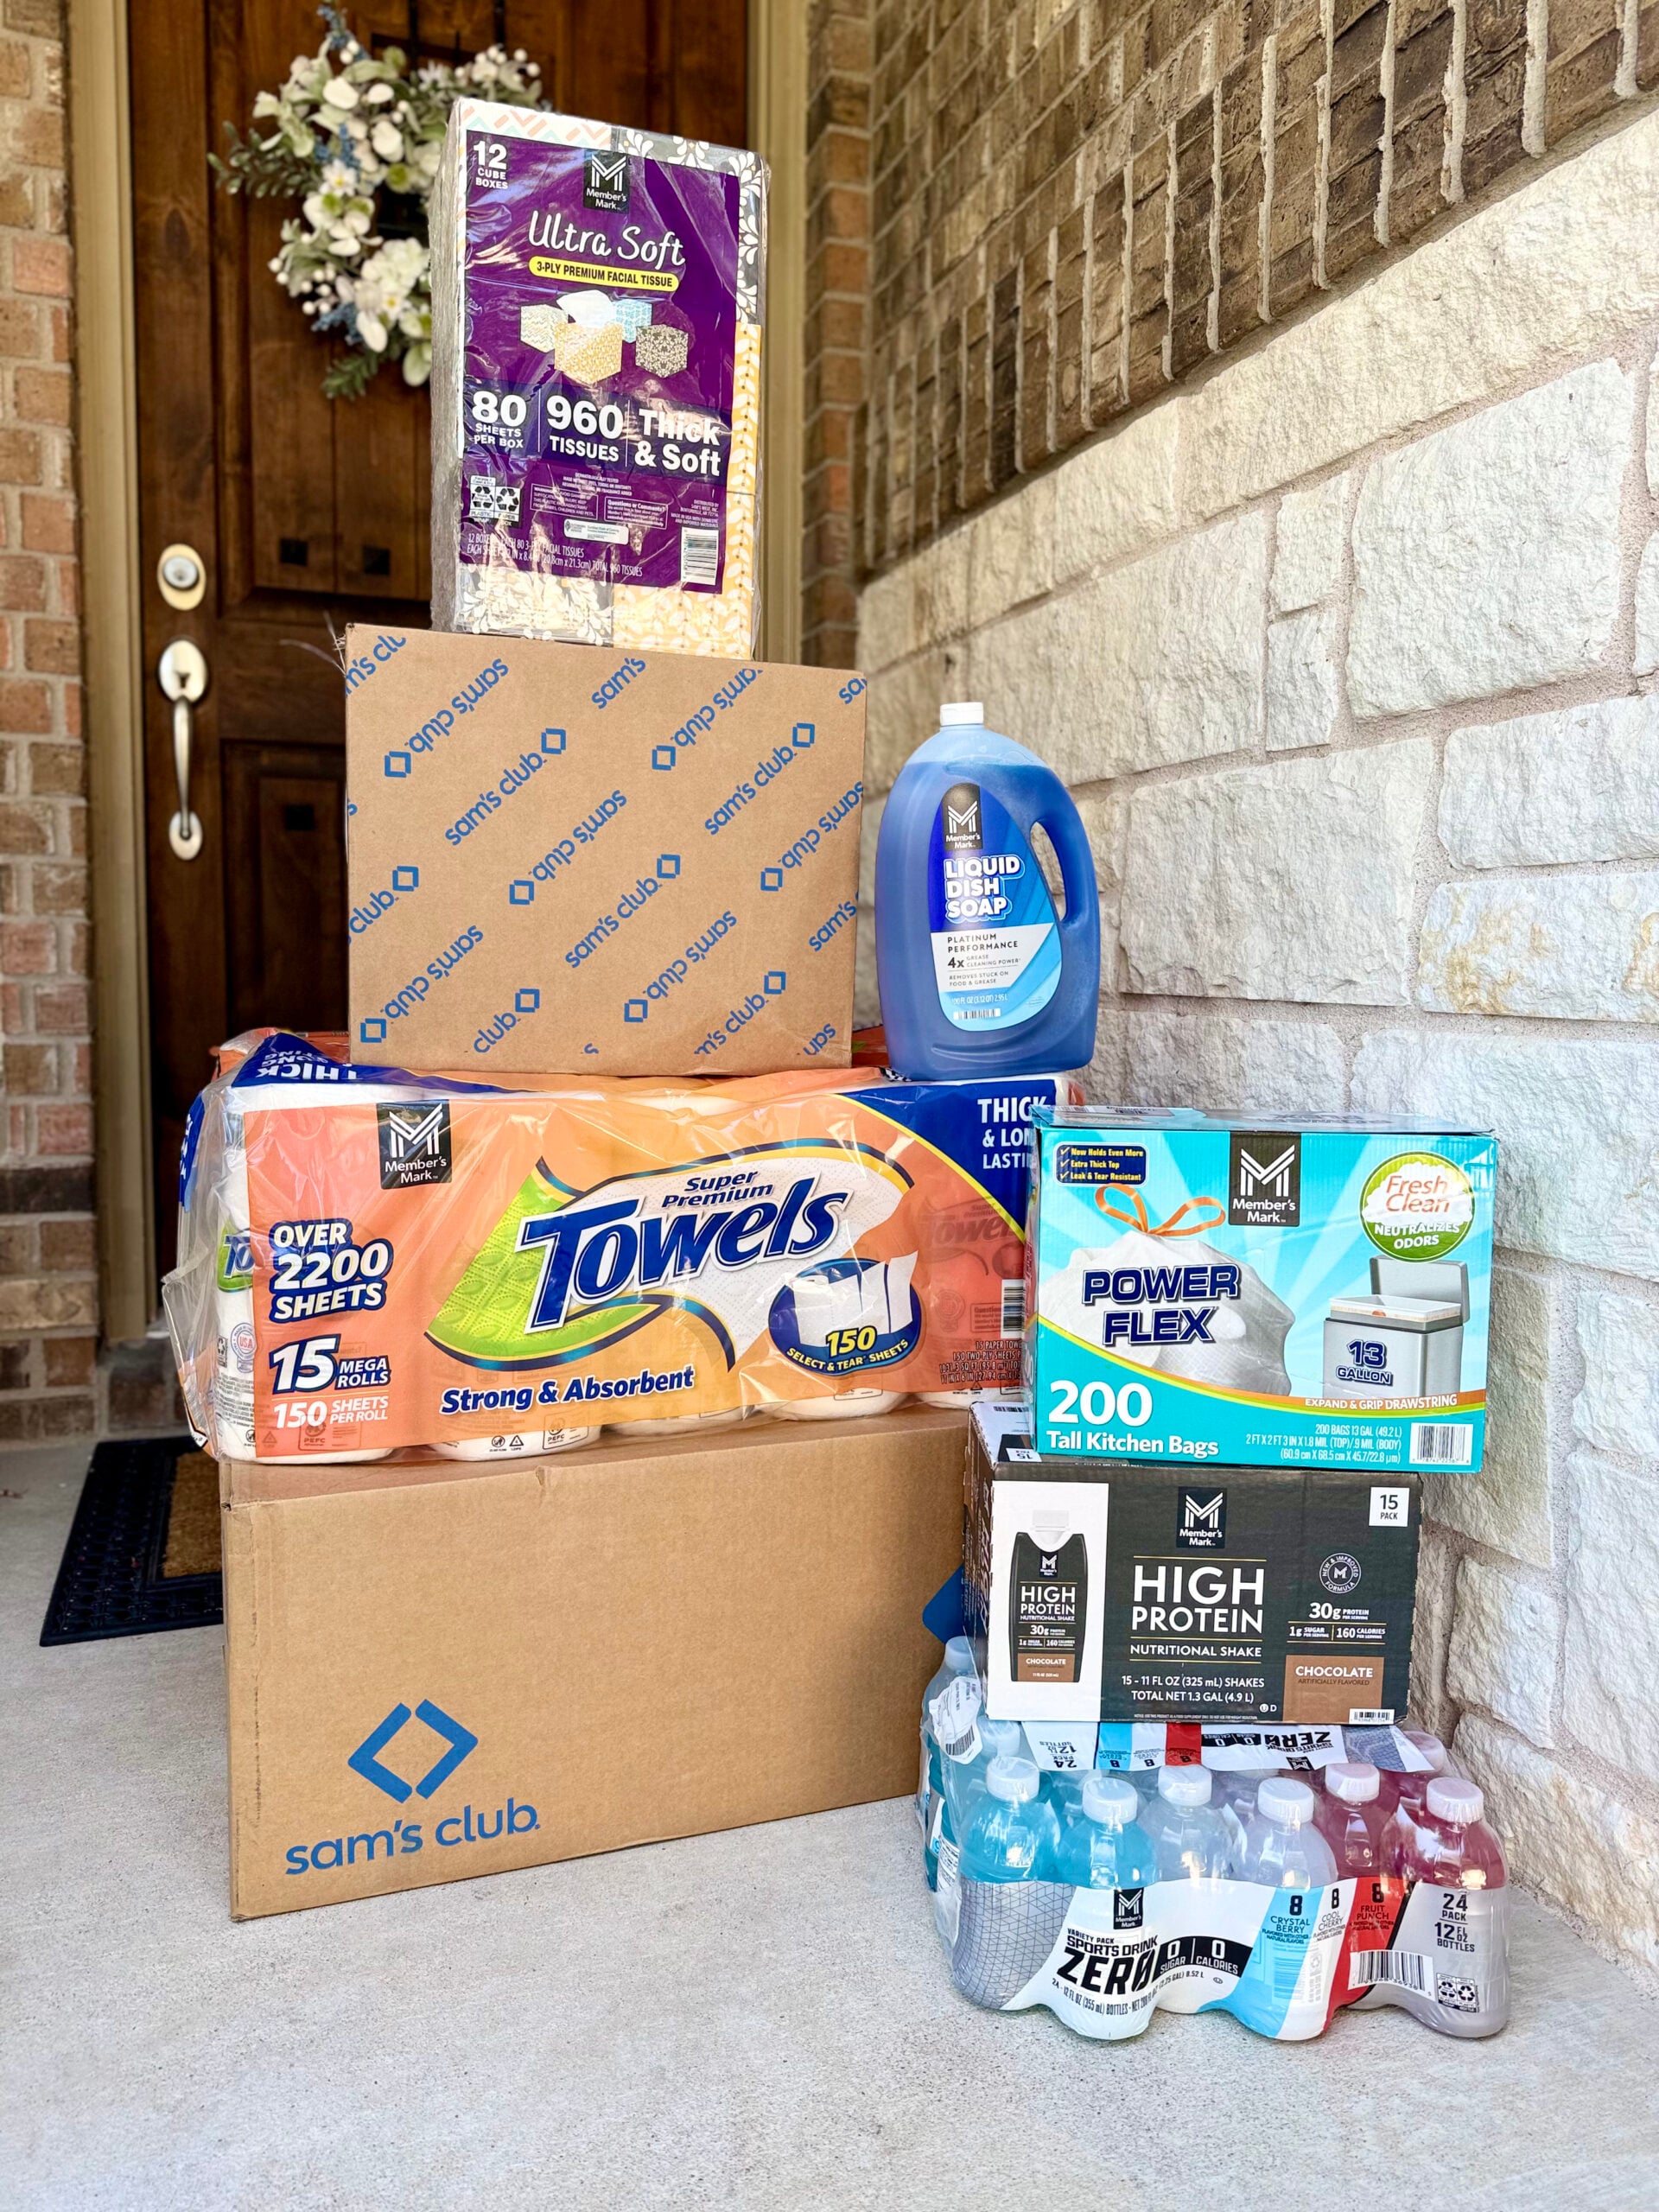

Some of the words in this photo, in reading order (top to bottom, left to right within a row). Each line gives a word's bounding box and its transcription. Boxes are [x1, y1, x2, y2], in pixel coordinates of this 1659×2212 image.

[474, 140, 507, 169] 12
[477, 168, 506, 181] CUBE
[476, 178, 508, 190] BOXES
[586, 188, 627, 202] Member's
[595, 198, 617, 209] Mark
[528, 210, 612, 257] Ultra
[617, 226, 686, 270] Soft
[537, 261, 561, 274] 3-PLY
[563, 264, 605, 280] PREMIUM
[607, 270, 639, 284] FACIAL
[641, 275, 672, 287] TISSUE
[472, 391, 526, 427] 80
[546, 396, 623, 439] 960
[475, 423, 522, 438] SHEETS
[639, 408, 721, 446] Thick
[474, 435, 496, 446] PER
[499, 436, 524, 448] BOX
[550, 435, 619, 462] TISSUES
[634, 444, 656, 468] &
[662, 445, 721, 476] Soft
[451, 658, 508, 714] sam's
[409, 709, 454, 753] club
[444, 791, 502, 845] sam's
[499, 752, 544, 795] club
[704, 782, 756, 836] sam's
[753, 745, 794, 786] club
[946, 833, 980, 842] Member's
[946, 856, 1020, 878] LIQUID
[947, 878, 999, 898] DISH
[947, 898, 1006, 918] SOAP
[565, 914, 619, 969] sam's
[617, 877, 658, 919] club
[685, 911, 737, 963] sam's
[947, 934, 996, 944] PLATINUM
[948, 941, 1018, 953] PERFORMANCE
[947, 957, 964, 968] 4x
[646, 959, 688, 1001] club
[385, 1156, 448, 1173] Member's
[400, 1170, 432, 1184] Mark
[684, 1170, 758, 1192] Super
[1386, 1175, 1447, 1193] Fresh
[661, 1185, 773, 1208] Premium
[1232, 1198, 1296, 1211] Member's
[1386, 1193, 1450, 1213] Clean
[1247, 1211, 1281, 1223] Mark
[273, 1222, 346, 1248] OVER
[1375, 1223, 1459, 1236] NEUTRALIZES
[1395, 1236, 1439, 1249] ODORS
[520, 1178, 849, 1329] Towels
[275, 1243, 388, 1289] 2200
[1083, 1265, 1239, 1303] POWER
[275, 1283, 382, 1319] SHEETS
[1104, 1308, 1213, 1344] FLEX
[239, 1336, 253, 1348] USA
[827, 1326, 876, 1356] 150
[787, 1348, 824, 1369] SELECT
[827, 1361, 836, 1371] &
[868, 1340, 908, 1363] SHEETS
[1348, 1340, 1385, 1367] 13
[272, 1336, 337, 1392] 15
[339, 1360, 387, 1374] MEGA
[337, 1371, 388, 1388] ROLLS
[1336, 1366, 1392, 1384] GALLON
[442, 1388, 532, 1414] Strong
[539, 1382, 557, 1404] &
[565, 1367, 694, 1402] Absorbent
[332, 1396, 388, 1412] SHEETS
[1049, 1380, 1153, 1427] 200
[1306, 1399, 1346, 1409] EXPAND
[1350, 1401, 1357, 1409] &
[1360, 1400, 1383, 1410] GRIP
[1386, 1395, 1457, 1410] DRAWSTRING
[273, 1401, 327, 1428] 150
[330, 1412, 358, 1424] PER
[359, 1409, 388, 1421] ROLL
[1046, 1431, 1080, 1449] Tall
[1087, 1432, 1163, 1452] Kitchen
[1169, 1435, 1218, 1459] Bags
[1381, 1495, 1398, 1510] 15
[1179, 1529, 1222, 1538] Member's
[1337, 1556, 1358, 1577] IMPROVED
[1134, 1565, 1264, 1605] HIGH
[1325, 1581, 1355, 1592] FORMULA
[1021, 1586, 1076, 1603] HIGH
[1020, 1604, 1075, 1615] PROTEIN
[1309, 1603, 1341, 1620] 30g
[1132, 1606, 1262, 1634] PROTEIN
[1289, 1626, 1302, 1637] 1g
[1337, 1628, 1355, 1638] 160
[1130, 1644, 1217, 1656] NUTRITIONAL
[1220, 1647, 1262, 1656] SHAKE
[1295, 1666, 1373, 1677] CHOCOLATE
[1122, 1675, 1132, 1685] 15
[1141, 1676, 1149, 1685] 11
[1153, 1676, 1162, 1685] FL
[1166, 1676, 1179, 1686] OZ
[1182, 1676, 1203, 1688] (325
[1205, 1677, 1223, 1688] mL)
[1224, 1678, 1264, 1688] SHAKES
[285, 1820, 423, 1875] sam's
[435, 1797, 537, 1847] club
[1443, 1893, 1467, 1911] 24
[1270, 1916, 1310, 1926] CRYSTAL
[1319, 1918, 1344, 1931] CHERRY
[1322, 1911, 1340, 1922] COOL
[1442, 1910, 1466, 1921] PACK
[1068, 1928, 1094, 1942] VARIETY
[1275, 1924, 1305, 1934] BERRY
[1434, 1923, 1454, 1940] 12
[1067, 1936, 1119, 1956] SPORTS
[1122, 1935, 1158, 1955] DRINK
[1167, 1940, 1180, 1959] 0
[1211, 1940, 1225, 1959] 0
[1437, 1939, 1474, 1952] BOTTLES
[1160, 1956, 1185, 1974] SUGAR
[1196, 1956, 1238, 1974] CALORIES
